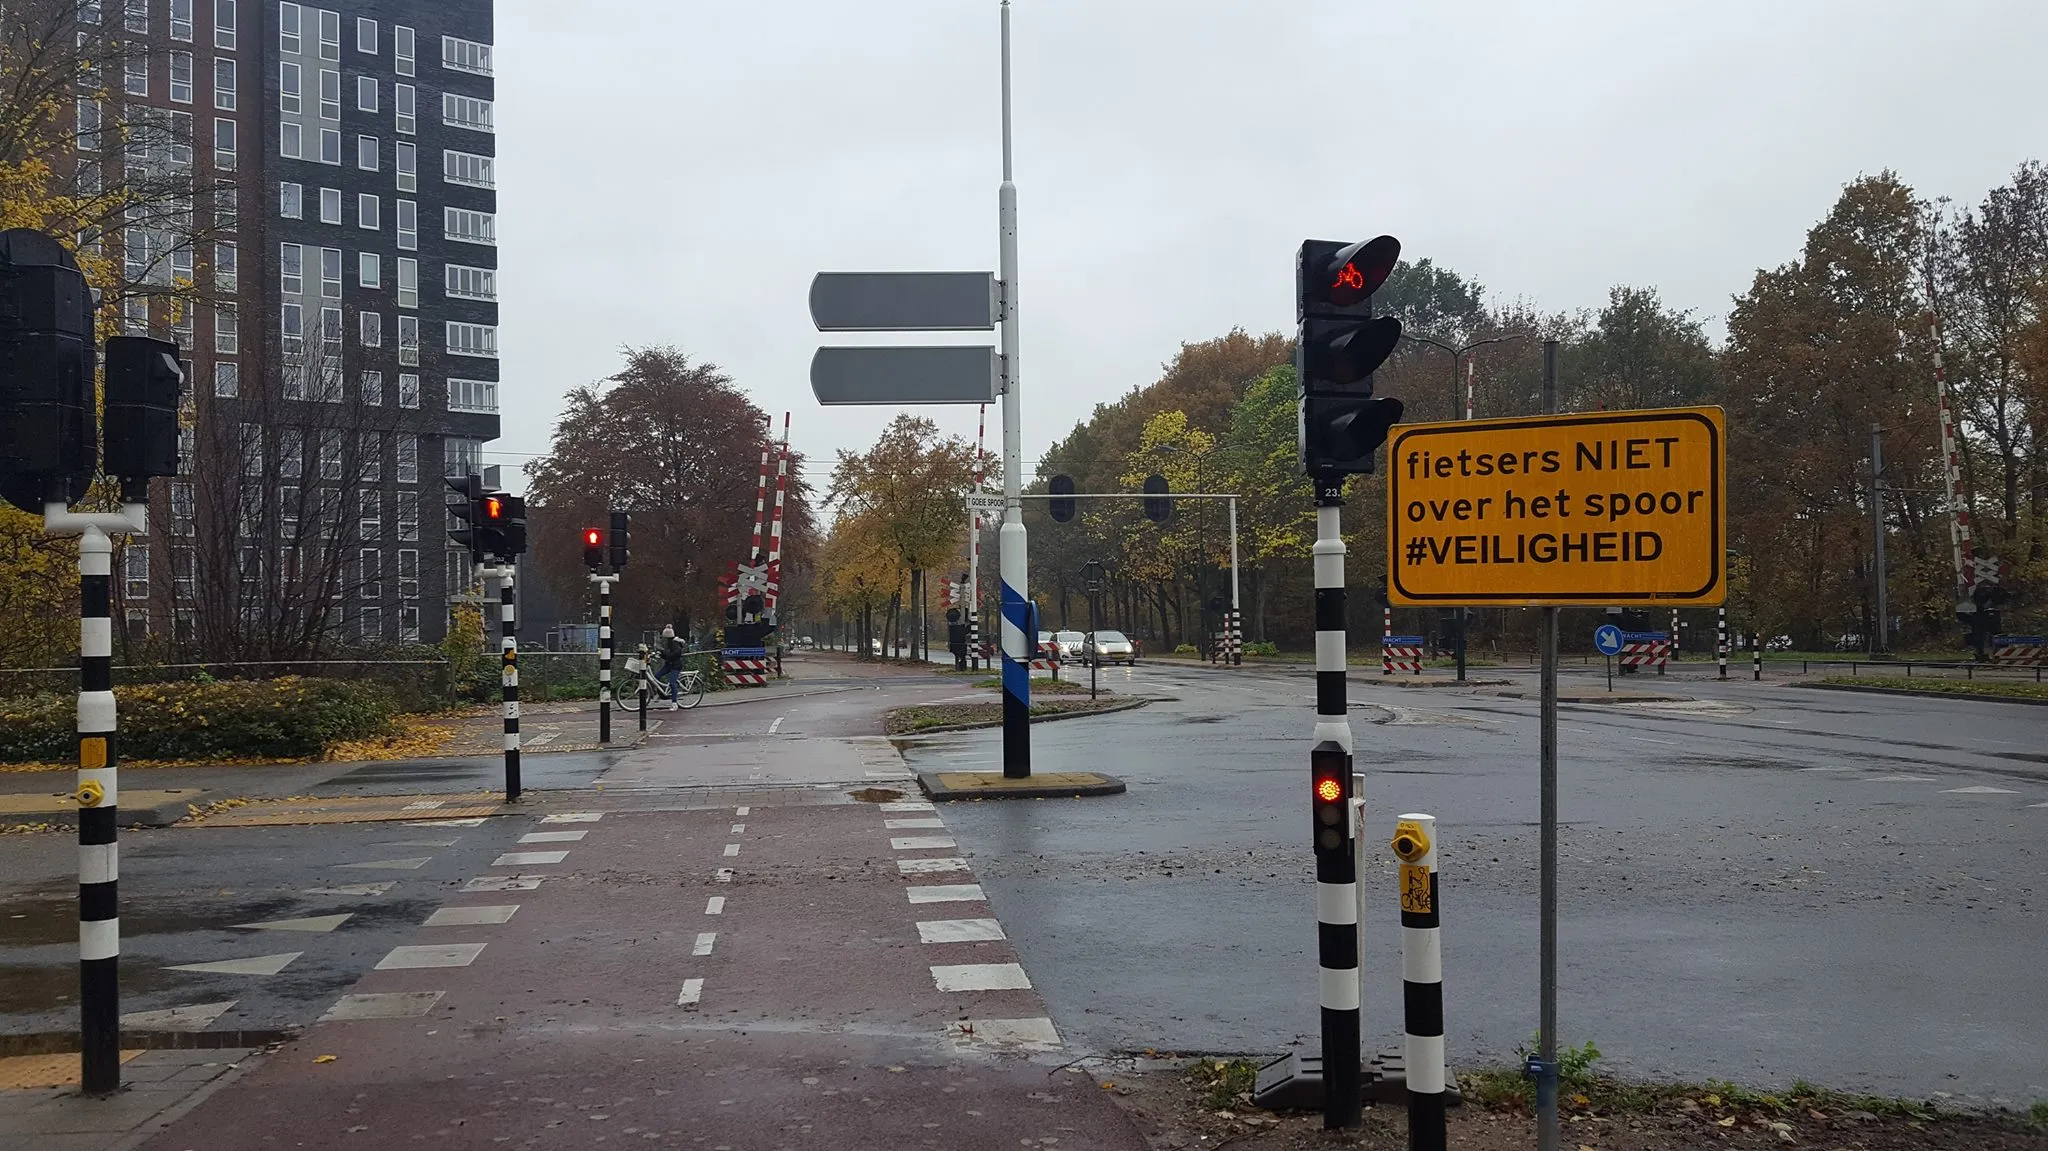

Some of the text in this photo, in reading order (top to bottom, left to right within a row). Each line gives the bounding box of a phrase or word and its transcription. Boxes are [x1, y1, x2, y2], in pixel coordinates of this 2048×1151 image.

[1406, 437, 1680, 479] fietsers NIET
[972, 498, 986, 506] GOEIE
[988, 498, 1004, 506] SPOOR
[1407, 489, 1704, 523] over het spoor
[1406, 531, 1663, 566] #VEILIGHEID
